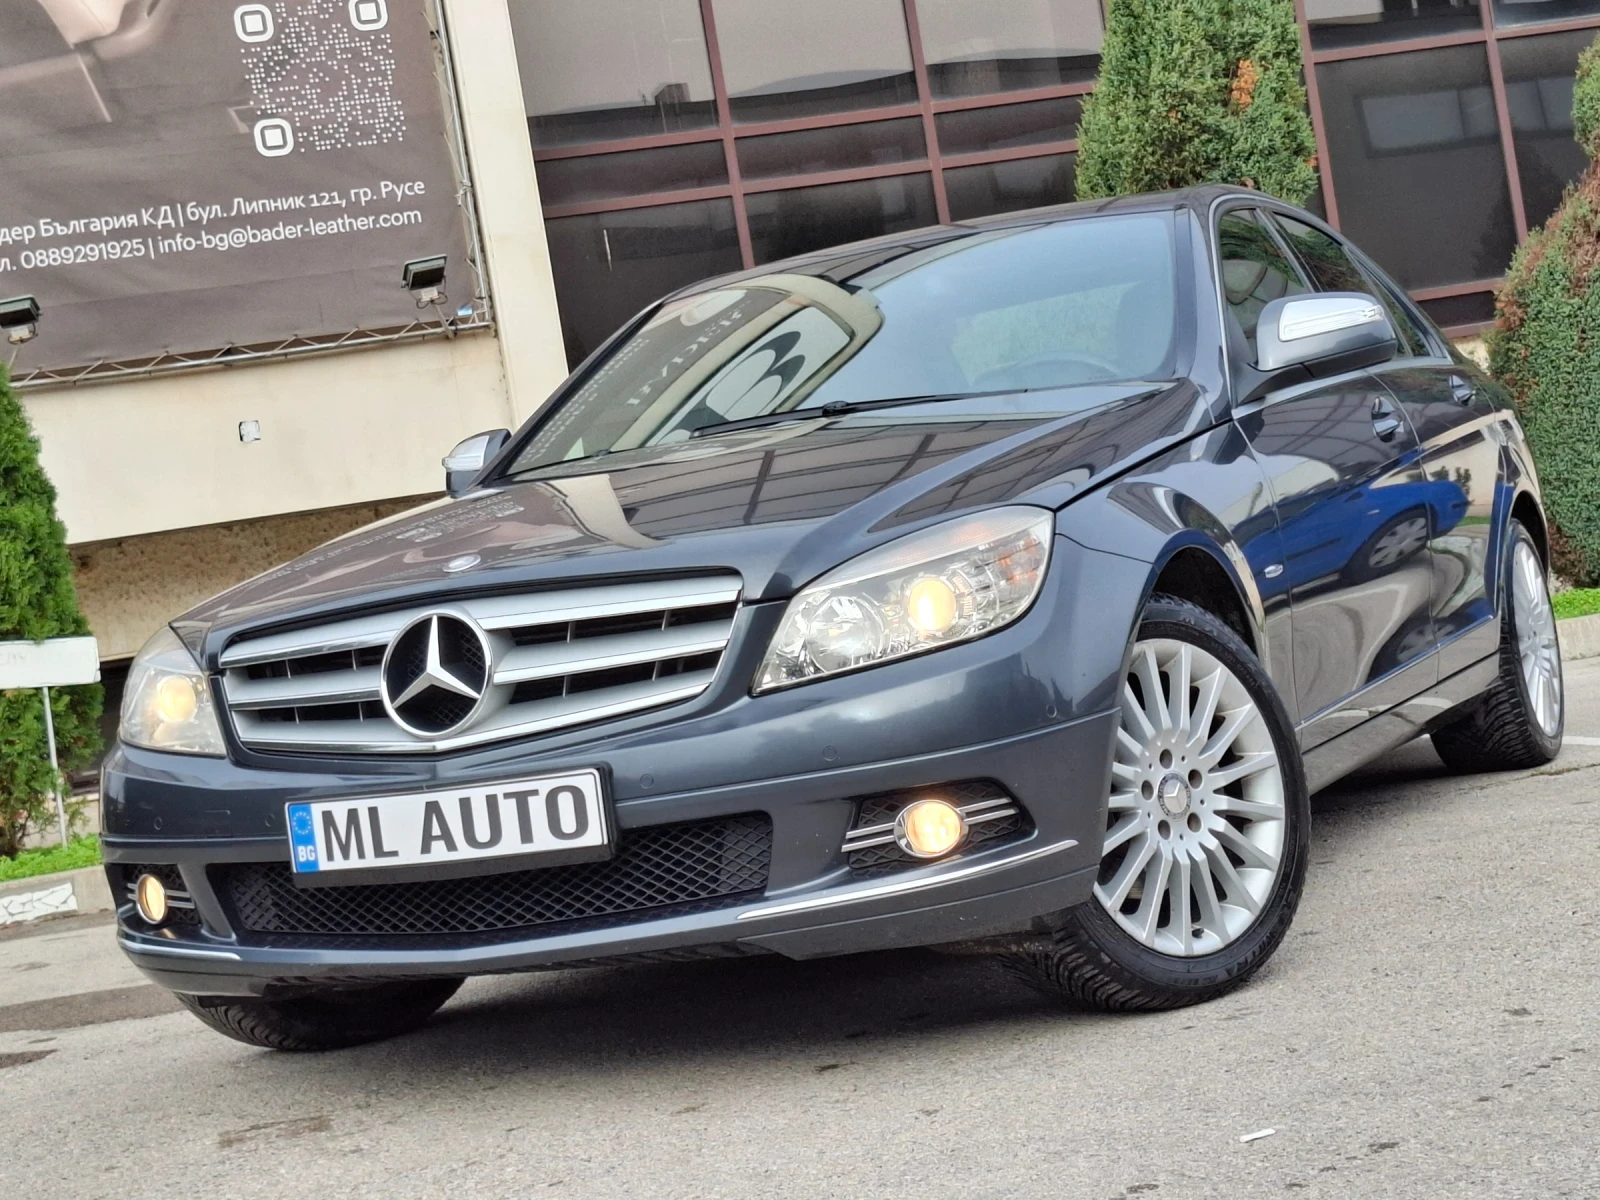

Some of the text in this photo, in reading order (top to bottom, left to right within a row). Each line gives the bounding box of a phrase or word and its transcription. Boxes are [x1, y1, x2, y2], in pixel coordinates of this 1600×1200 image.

[39, 218, 139, 236] България
[186, 201, 227, 225] бул.
[230, 195, 306, 217] Липник
[308, 191, 347, 208] 121,
[350, 187, 377, 207] гр.
[380, 180, 426, 203] Русе
[20, 238, 146, 269] 0889291925
[157, 209, 422, 254] info-bg@bader-leather.com
[320, 784, 589, 862] ML AUTO
[298, 845, 316, 862] BG
